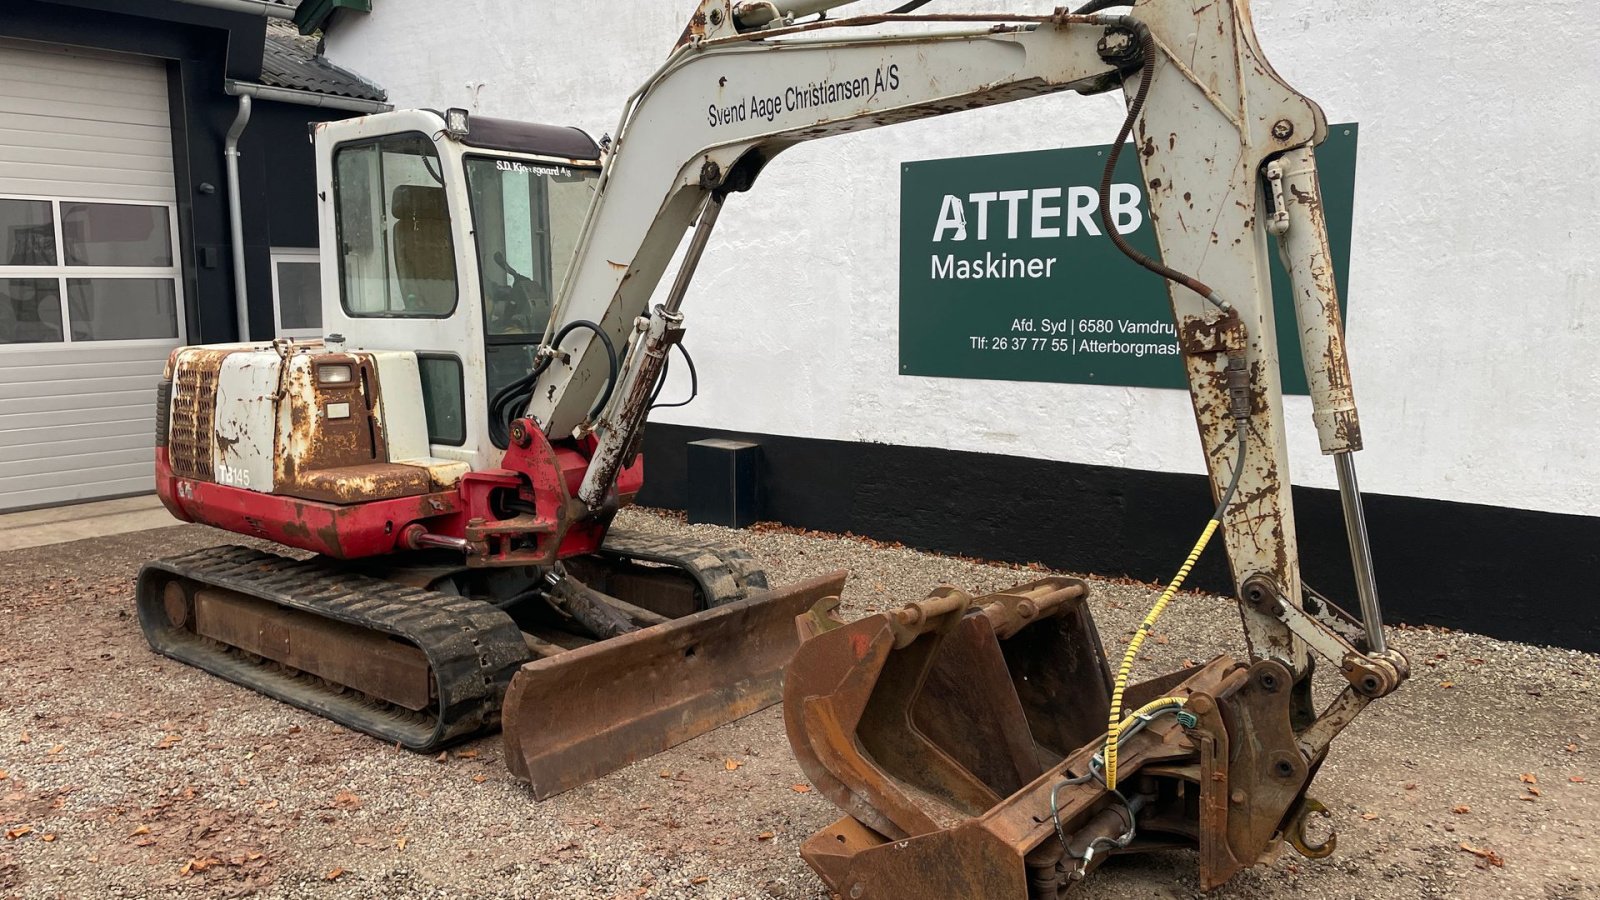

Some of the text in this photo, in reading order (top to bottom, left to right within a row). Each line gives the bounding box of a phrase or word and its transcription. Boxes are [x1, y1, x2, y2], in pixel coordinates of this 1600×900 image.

[708, 64, 900, 127] Svend Aage Christiansen A/S
[932, 182, 1151, 242] ATTERB
[931, 251, 1057, 279] Maskiner
[1011, 318, 1037, 332] Afd.
[1041, 318, 1067, 335] Syd
[1078, 319, 1114, 333] 6580
[1117, 319, 1177, 337] Vamdru
[969, 336, 988, 349] Tlf:
[991, 336, 1008, 350] 26
[1011, 337, 1027, 351] 37
[1031, 337, 1048, 351] 77
[1051, 338, 1068, 352] 55
[219, 464, 250, 486] TB145
